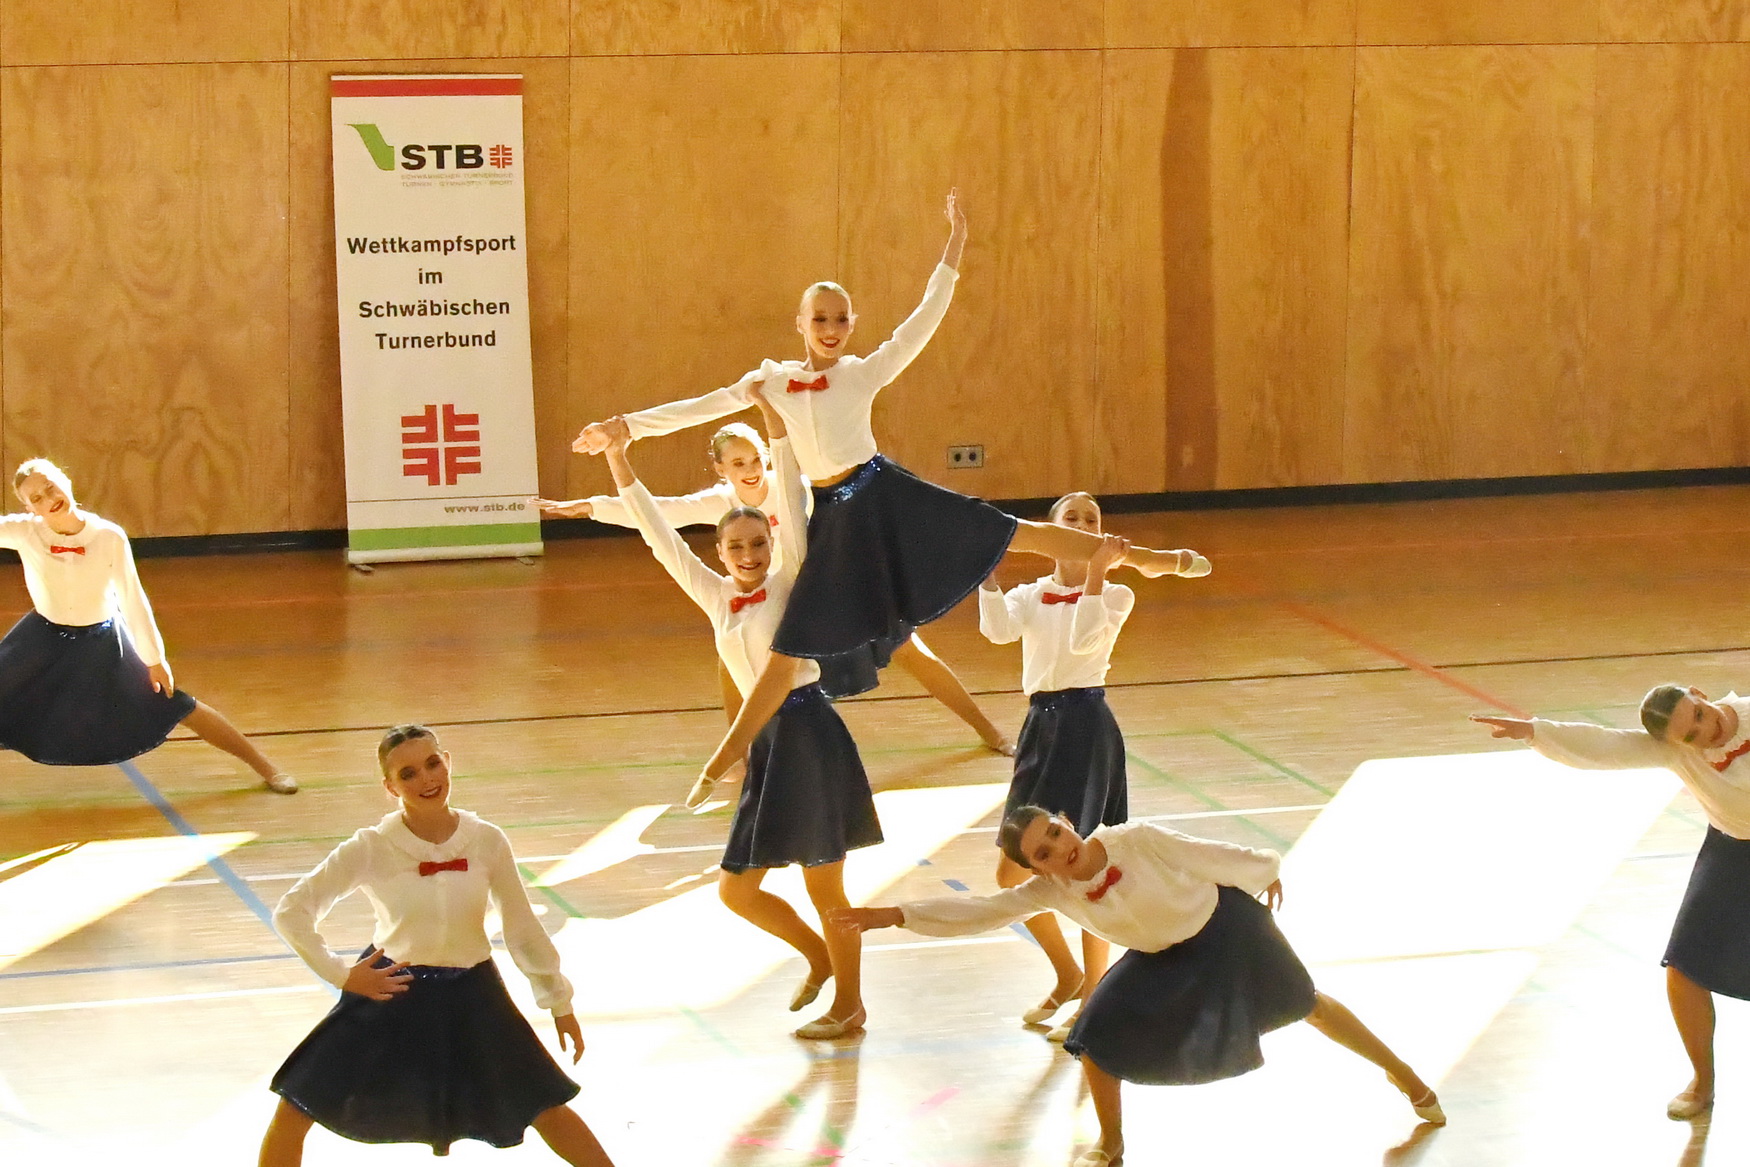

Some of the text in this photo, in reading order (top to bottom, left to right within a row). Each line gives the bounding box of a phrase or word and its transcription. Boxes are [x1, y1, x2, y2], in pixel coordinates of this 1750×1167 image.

[401, 144, 484, 171] STB
[347, 235, 516, 256] Wettkampfsport
[418, 268, 443, 285] im
[359, 299, 510, 319] Schwäbischen
[375, 330, 496, 350] Turnerbund
[444, 502, 525, 514] www.stb.de
